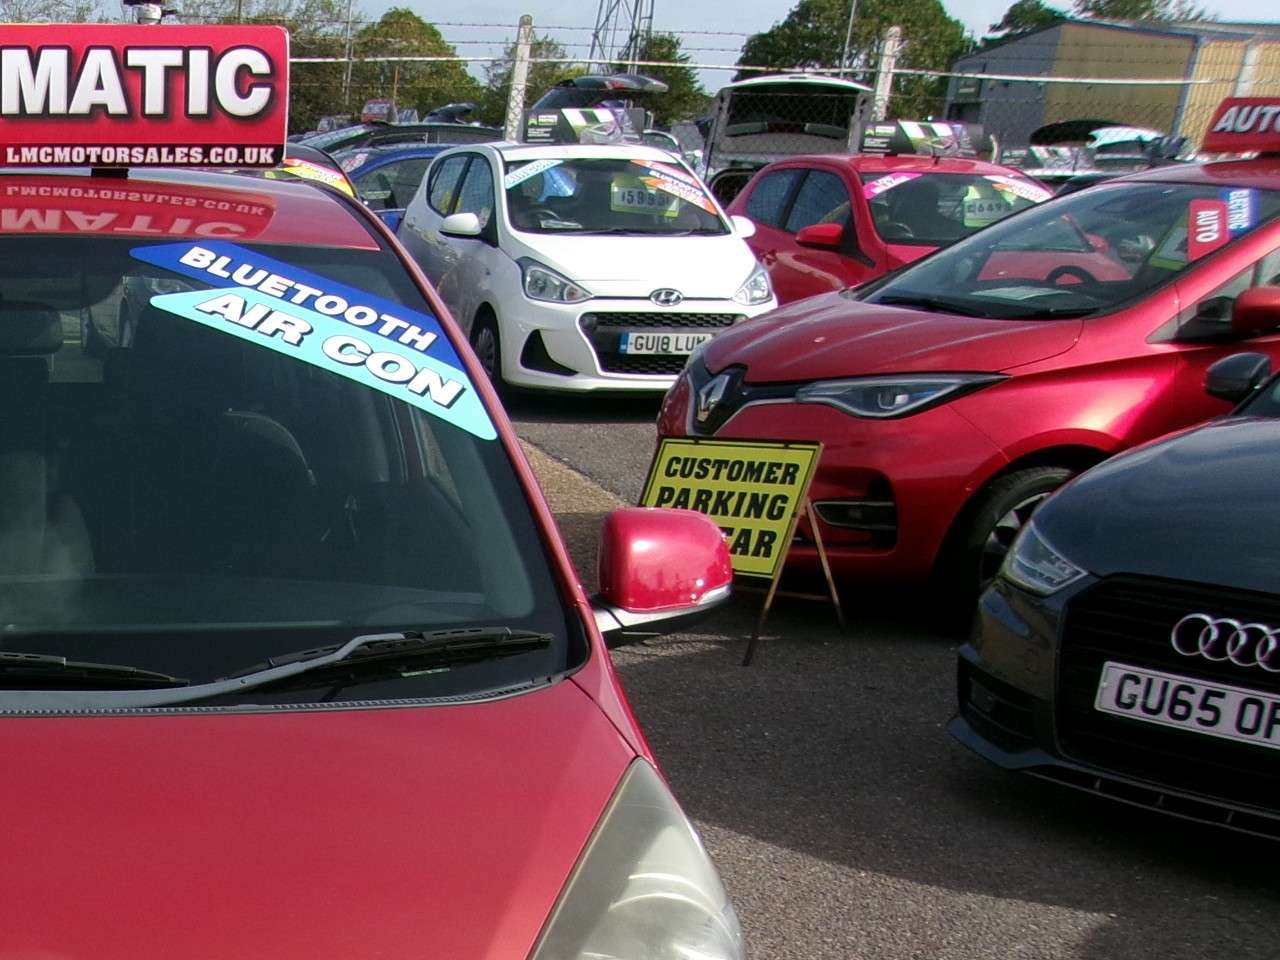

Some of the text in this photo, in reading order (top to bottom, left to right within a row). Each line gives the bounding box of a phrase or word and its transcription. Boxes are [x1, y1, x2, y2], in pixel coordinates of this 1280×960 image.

[1212, 105, 1280, 133] AUT
[5, 147, 275, 164] LMCMOTORSALES.CO.UK
[1195, 210, 1220, 243] AUTO
[178, 246, 438, 351] BLUETOOTH
[194, 293, 467, 409] AIR CON
[634, 336, 671, 352] GU18
[664, 456, 800, 486] CUSTOMER
[656, 486, 789, 521] PARKING
[1114, 673, 1226, 727] GU65
